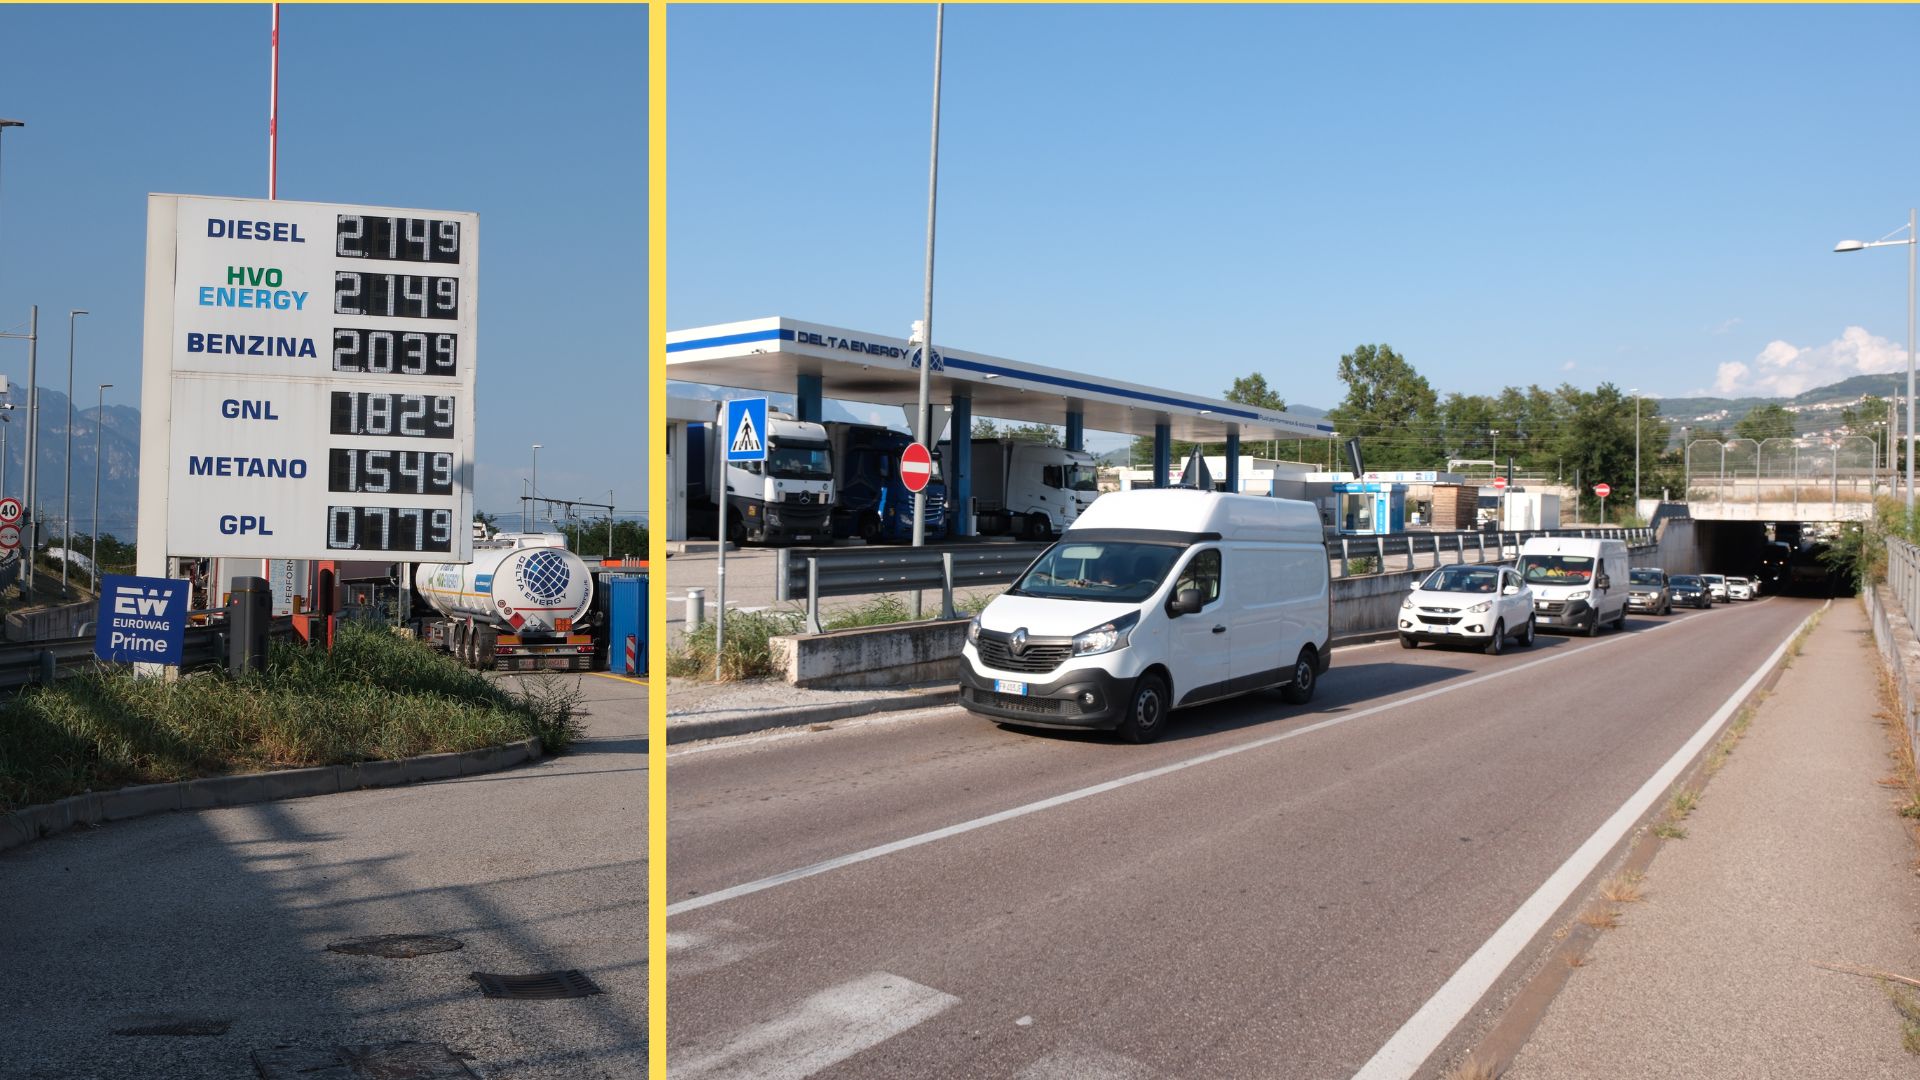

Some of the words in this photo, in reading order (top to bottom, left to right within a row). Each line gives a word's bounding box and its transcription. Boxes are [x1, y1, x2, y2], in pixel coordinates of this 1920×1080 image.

[207, 218, 306, 243] DIESEL
[227, 266, 283, 288] HVO
[199, 286, 309, 310] ENERGY
[187, 333, 318, 358] BENZINA
[221, 399, 279, 421] GNL
[188, 456, 307, 479] METANO
[2, 505, 17, 516] 40
[219, 515, 273, 536] GPL
[515, 556, 526, 591] DELTA
[114, 586, 173, 617] EW
[524, 592, 567, 606] ENERGY
[112, 618, 170, 631] EUROWAG
[110, 631, 168, 653] Prime
